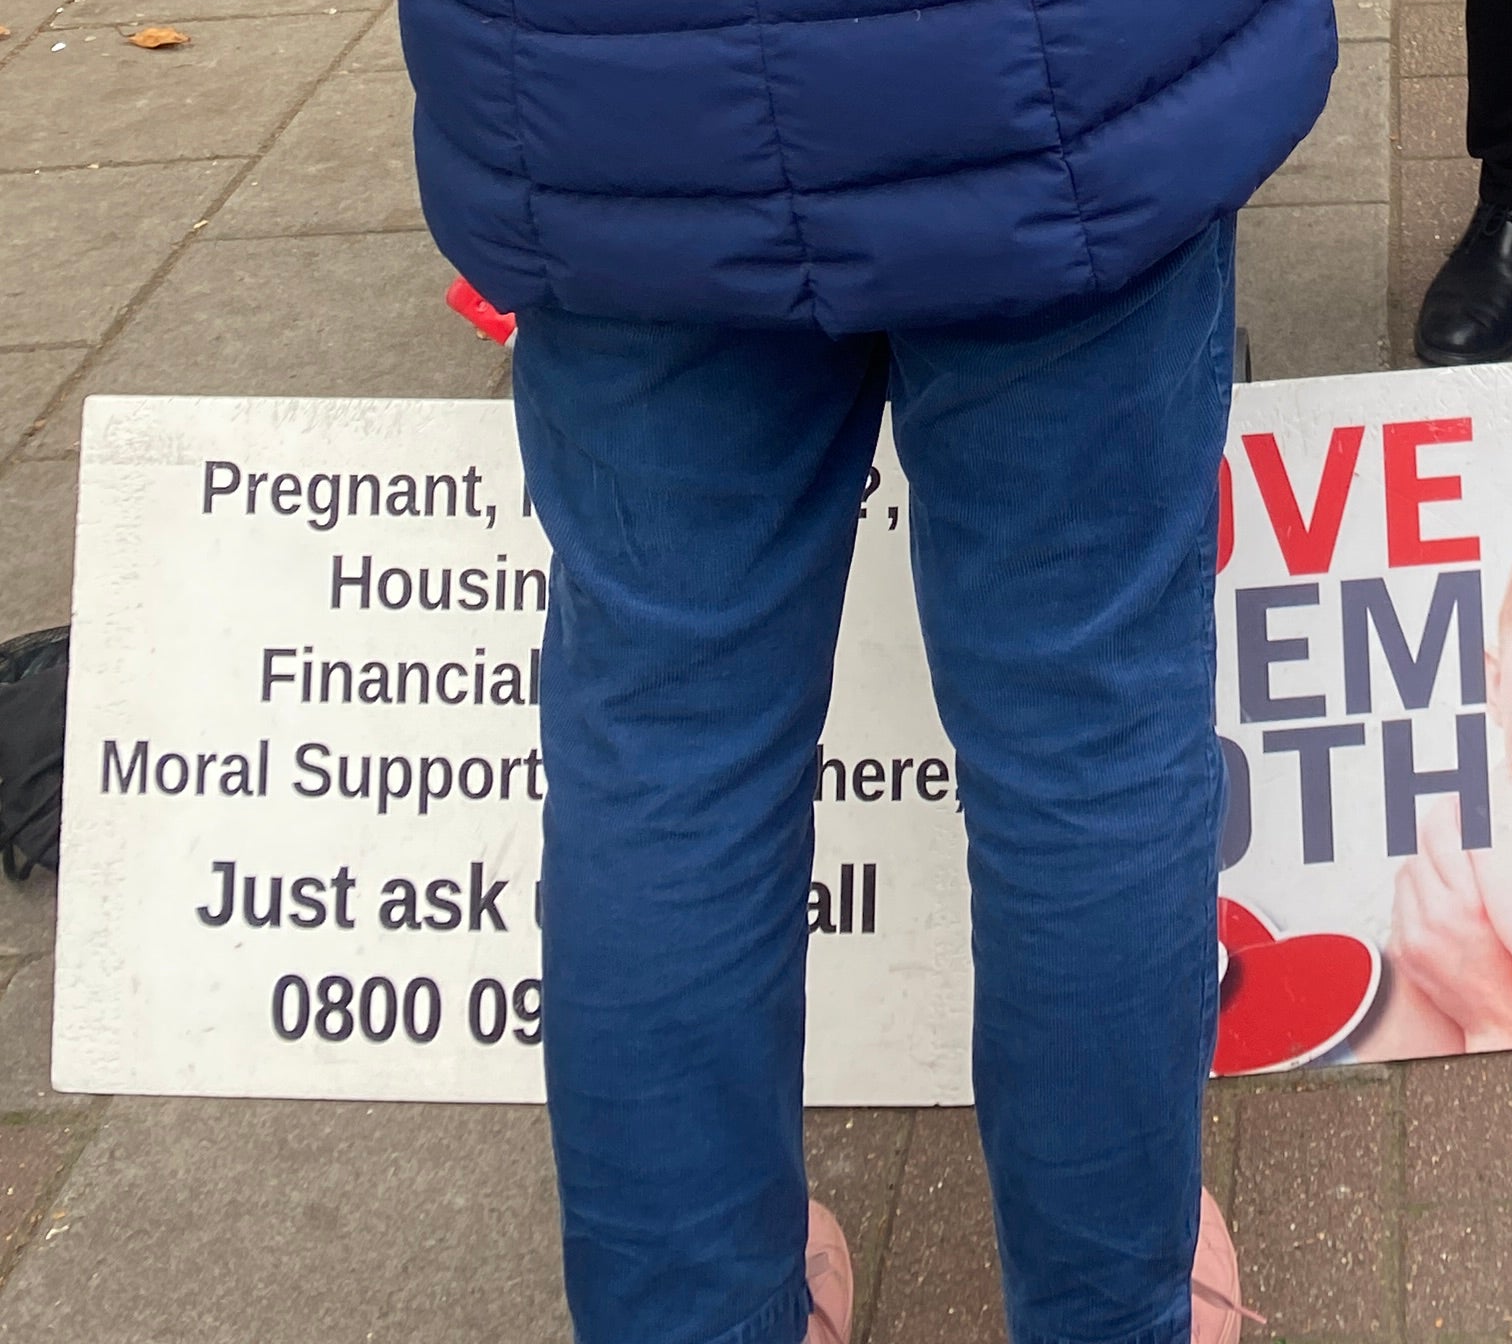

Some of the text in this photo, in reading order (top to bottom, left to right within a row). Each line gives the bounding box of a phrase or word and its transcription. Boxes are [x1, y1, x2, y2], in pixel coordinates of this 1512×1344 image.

[201, 461, 499, 531] Pregnant,
[1216, 416, 1482, 576] VE
[330, 554, 548, 612] Housin
[259, 646, 540, 706] Financial
[1235, 568, 1488, 725] EM
[101, 739, 269, 798] Moral
[294, 741, 544, 816] Support
[1218, 711, 1494, 873] TH
[197, 861, 356, 930] Just
[380, 861, 509, 933] ask
[806, 863, 878, 934] all
[270, 973, 543, 1046] 0800 09
